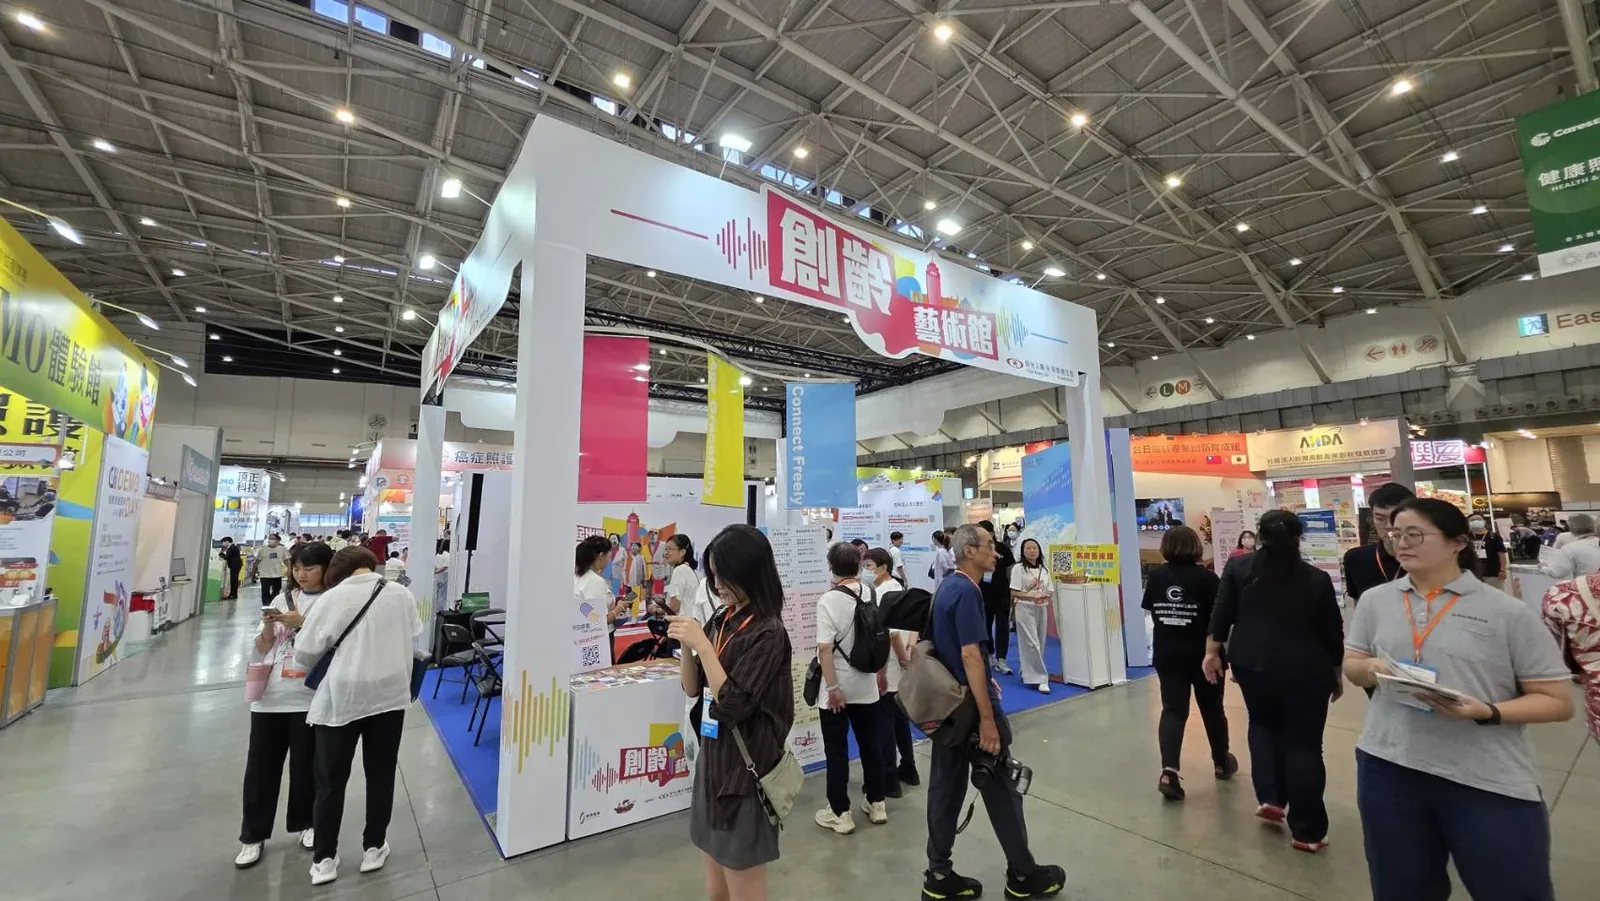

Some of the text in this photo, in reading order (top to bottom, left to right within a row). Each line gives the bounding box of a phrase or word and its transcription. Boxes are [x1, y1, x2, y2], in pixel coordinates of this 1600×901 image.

[1551, 177, 1589, 192] HEALTH
[779, 207, 893, 316] 創齡
[913, 305, 994, 356] 藝術館
[1163, 382, 1188, 395] L M
[704, 358, 719, 497] Age Gracefully
[790, 386, 805, 505] Connect Freely
[236, 482, 260, 493] 科技
[238, 471, 260, 483] 頂正
